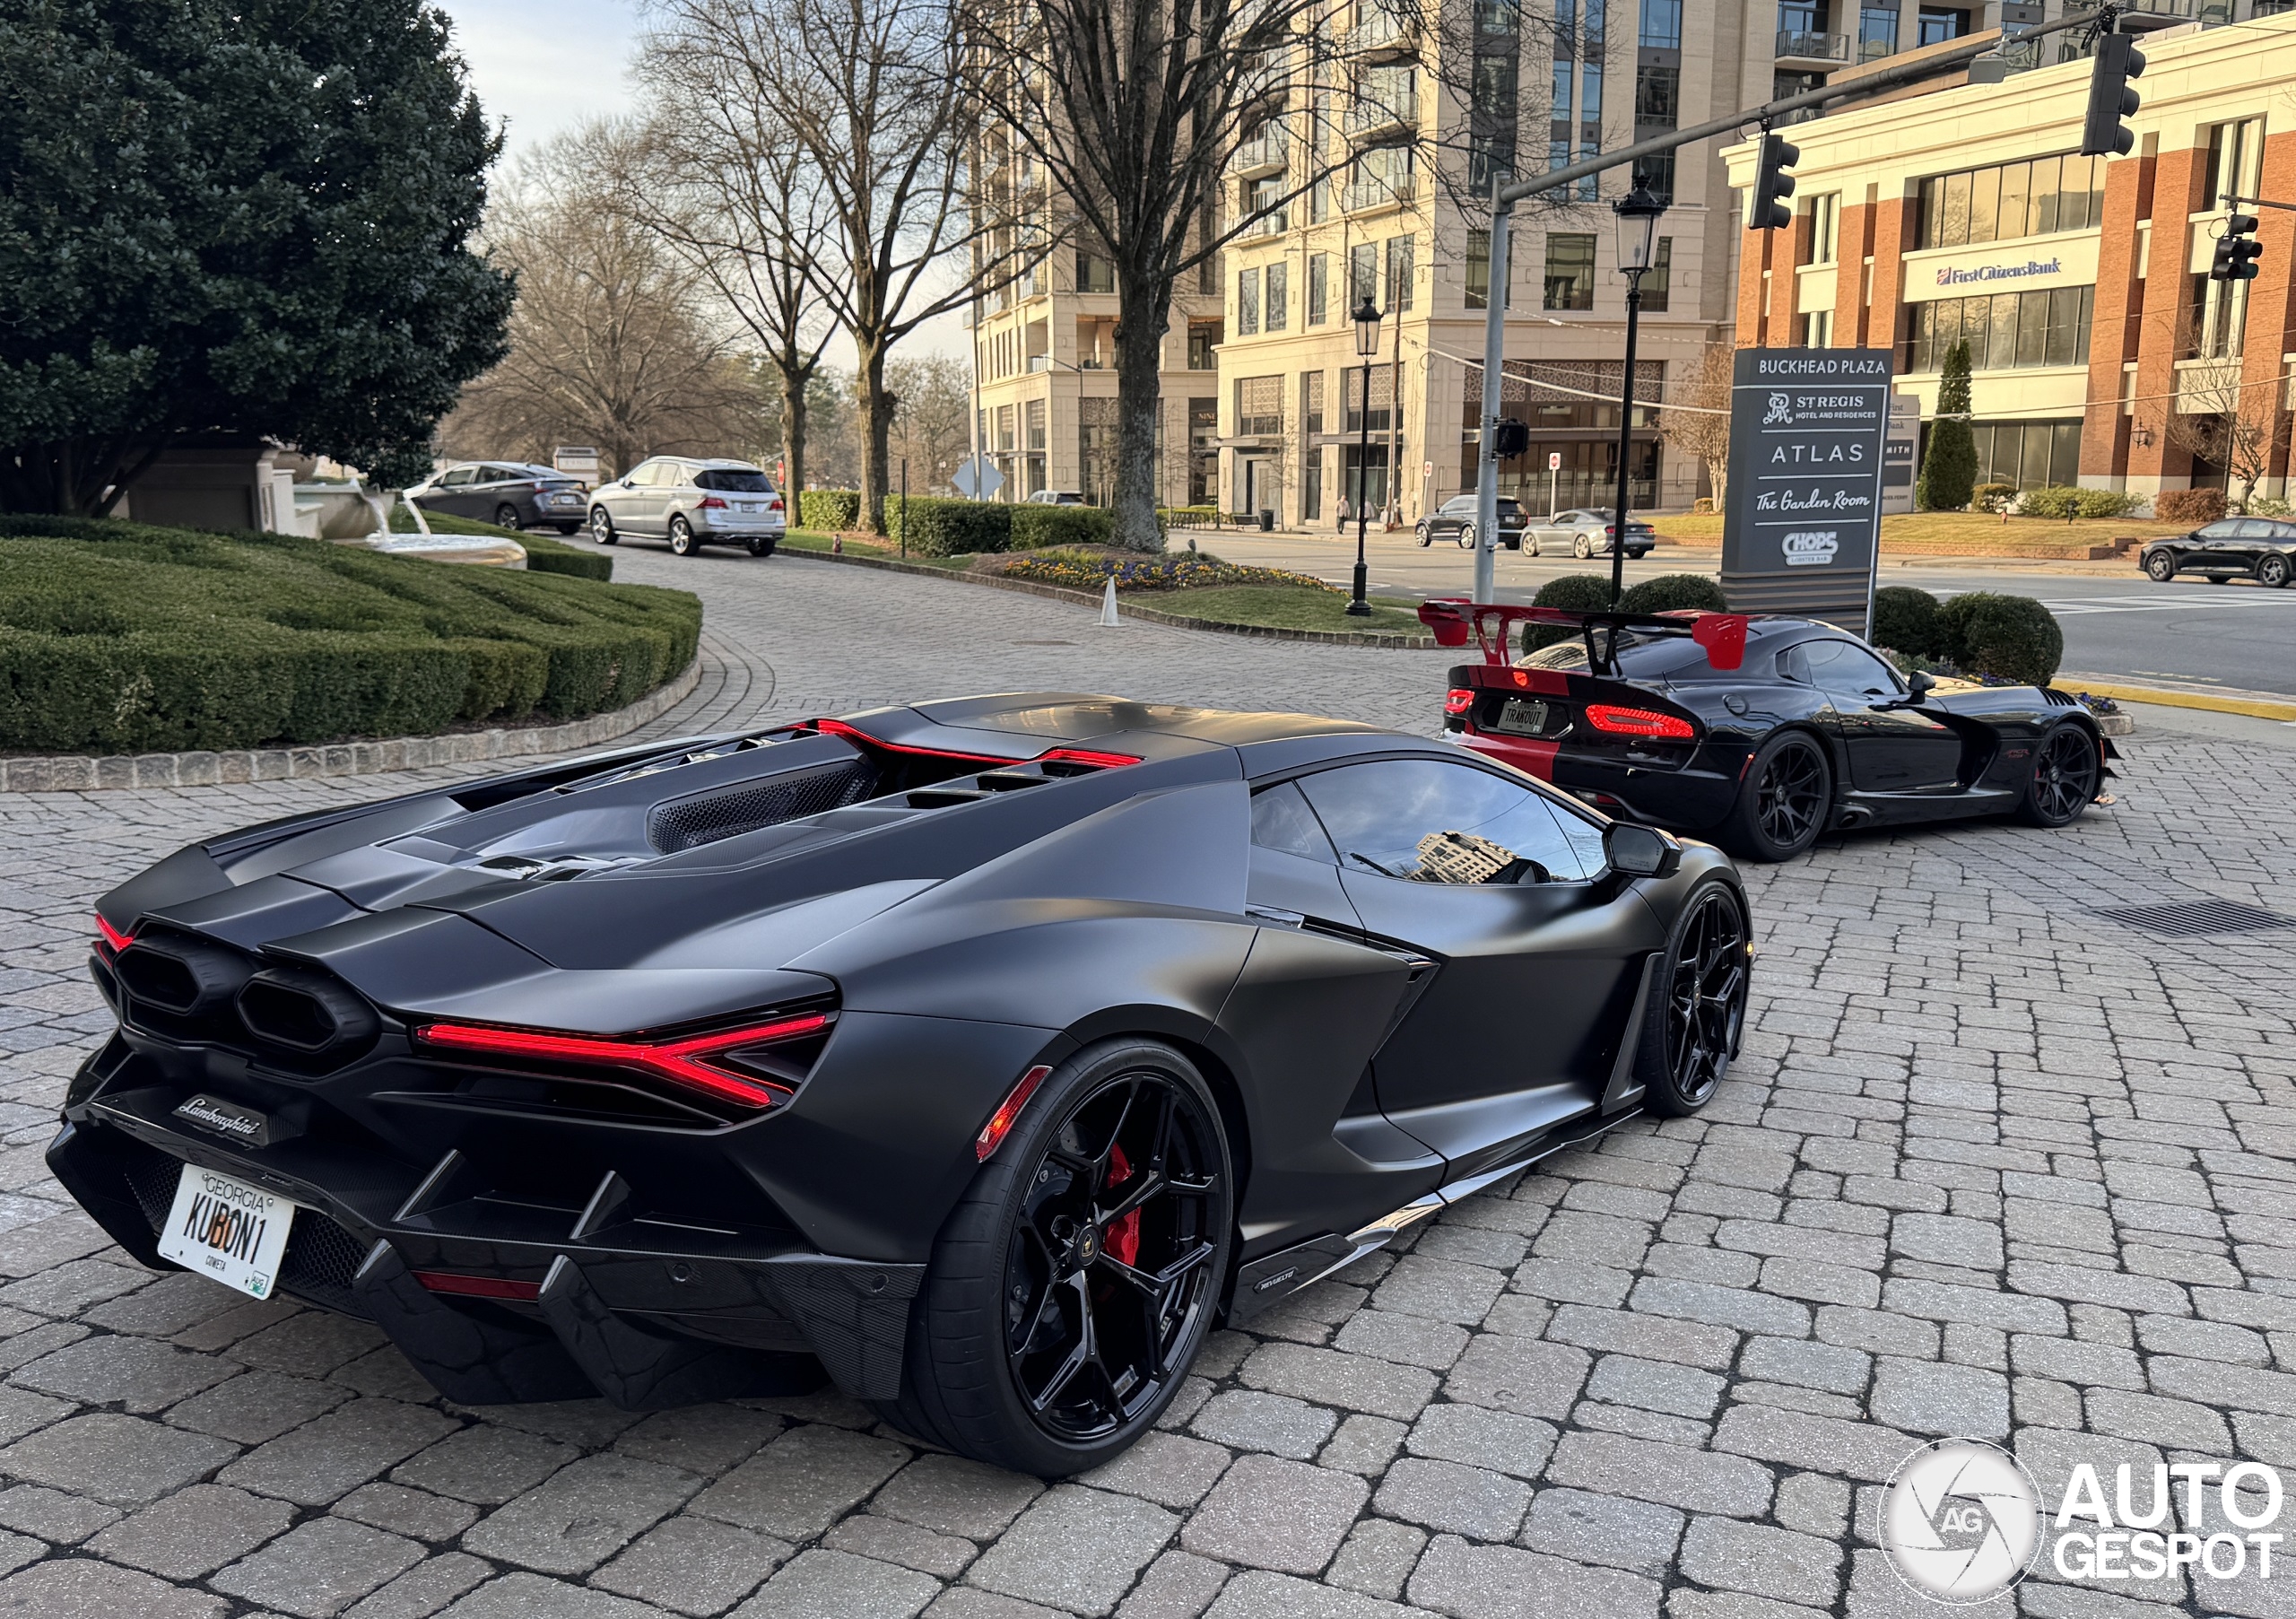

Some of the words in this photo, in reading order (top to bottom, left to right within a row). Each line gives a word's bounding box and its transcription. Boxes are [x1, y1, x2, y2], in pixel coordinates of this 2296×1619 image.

[1759, 360, 1838, 375] BUCKHEAD
[1841, 360, 1885, 374] PLAZA
[1817, 396, 1864, 408] REGIS
[1796, 412, 1818, 420] HOTEL
[1834, 411, 1876, 419] RESIDENCES
[1771, 443, 1864, 464] ATLAS
[1756, 492, 1777, 511] The
[1780, 489, 1831, 511] Garden
[1832, 490, 1871, 510] Room
[1782, 531, 1839, 556] CHOPS
[178, 1098, 262, 1136] Lamborghini
[205, 1177, 265, 1213] GEORGIA
[205, 1255, 227, 1271] COWETA
